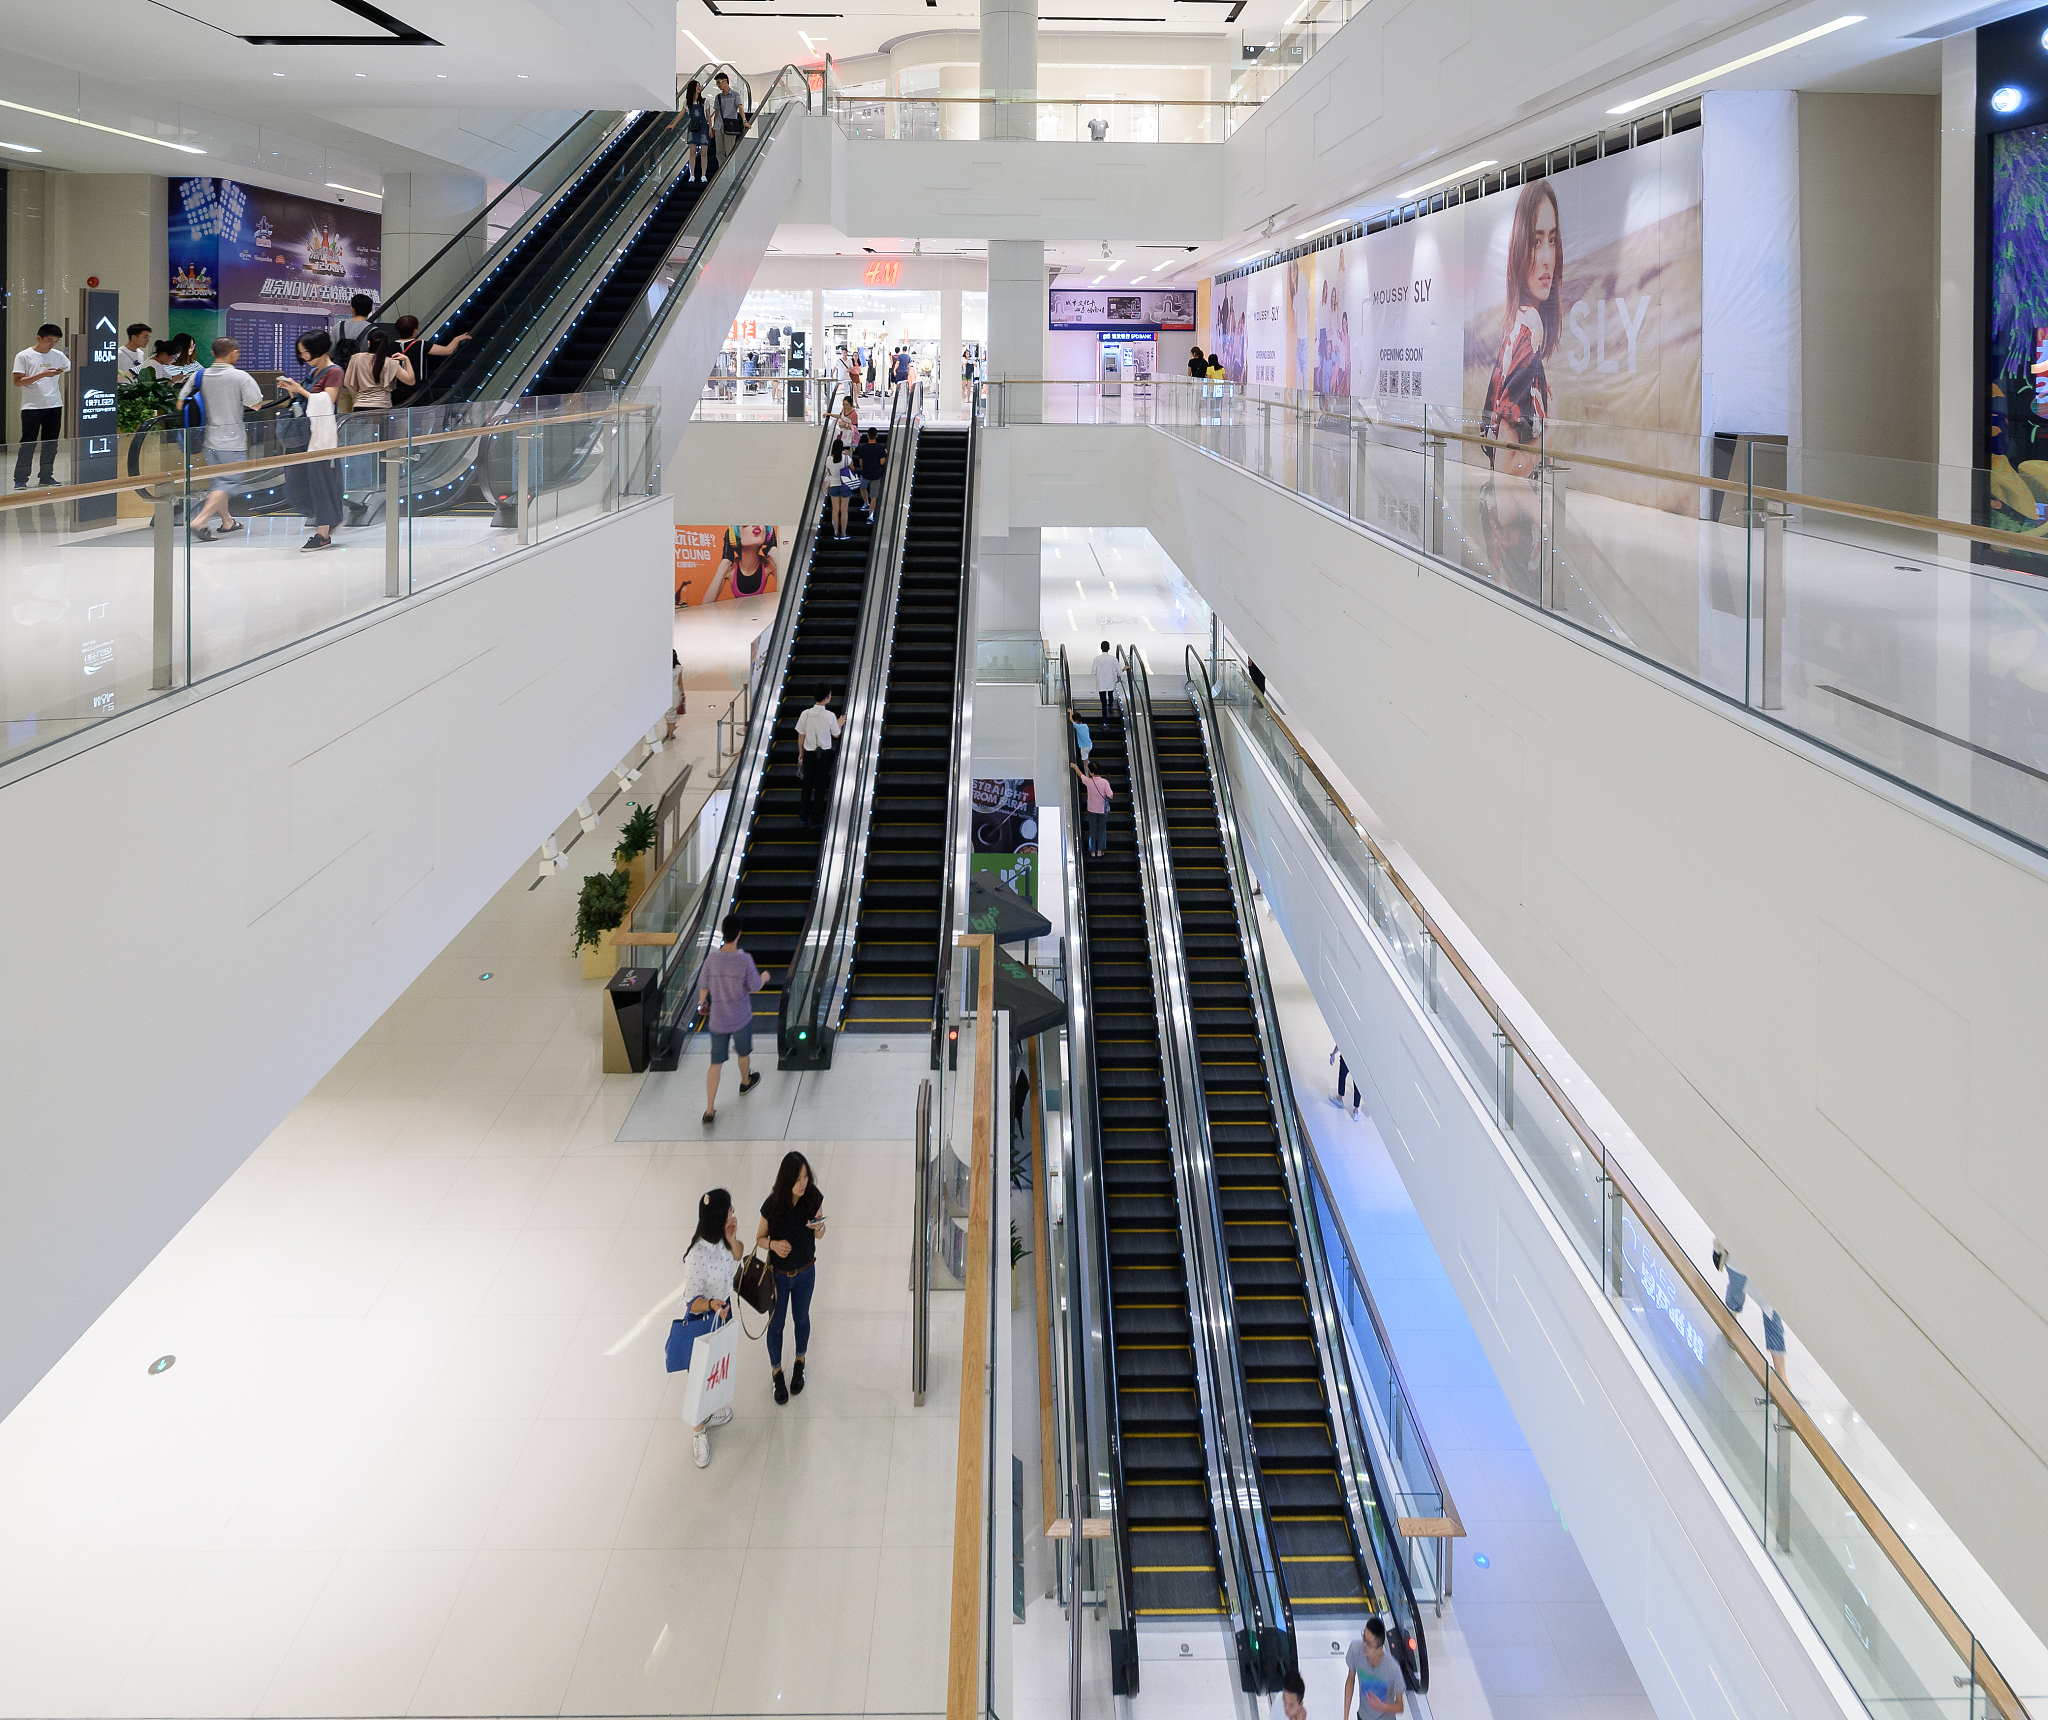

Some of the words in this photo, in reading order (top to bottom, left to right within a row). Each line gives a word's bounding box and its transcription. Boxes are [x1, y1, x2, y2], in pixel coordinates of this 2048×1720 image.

[863, 261, 900, 286] H&M
[1372, 286, 1409, 306] MOUSSY
[1414, 278, 1432, 303] SLY
[1271, 306, 1280, 321] SLY
[1567, 295, 1652, 374] SLY
[103, 341, 117, 350] L2
[1379, 348, 1404, 362] OPENING
[1405, 347, 1424, 362] SOON
[89, 438, 111, 454] L1
[674, 548, 711, 561] YOUNG
[973, 779, 1029, 802] STRAIGHT
[999, 796, 1028, 812] FARM
[706, 1352, 731, 1391] H&M
